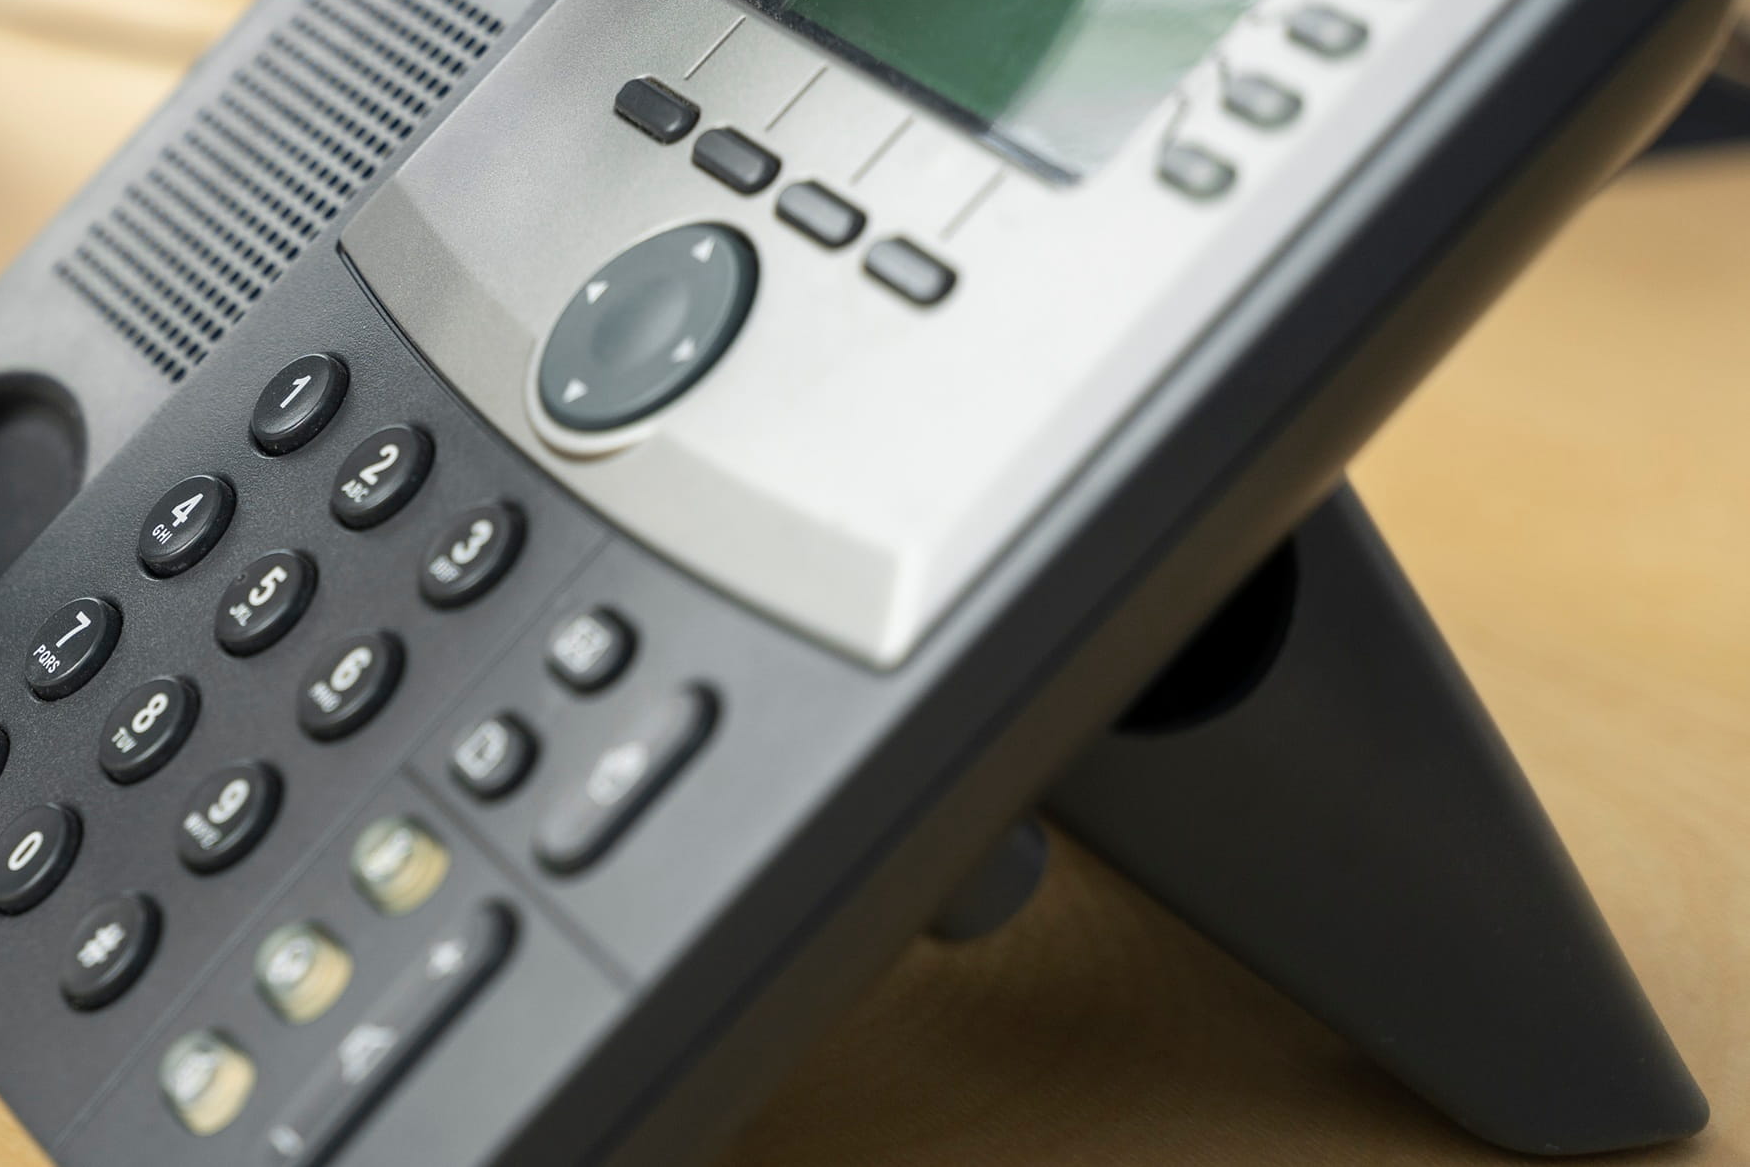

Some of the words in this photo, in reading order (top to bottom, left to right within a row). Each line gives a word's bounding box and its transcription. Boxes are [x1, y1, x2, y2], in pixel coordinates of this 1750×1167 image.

[280, 375, 311, 408] 1
[360, 445, 398, 485] 2
[172, 494, 203, 527] 4
[153, 524, 172, 544] GHI
[452, 520, 492, 563] 3
[249, 567, 286, 606] 5
[56, 611, 91, 647] 7
[33, 644, 60, 673] PQRS
[331, 648, 371, 691] 6
[132, 693, 168, 733] 8
[208, 780, 249, 823] 9
[8, 832, 43, 870] 0
